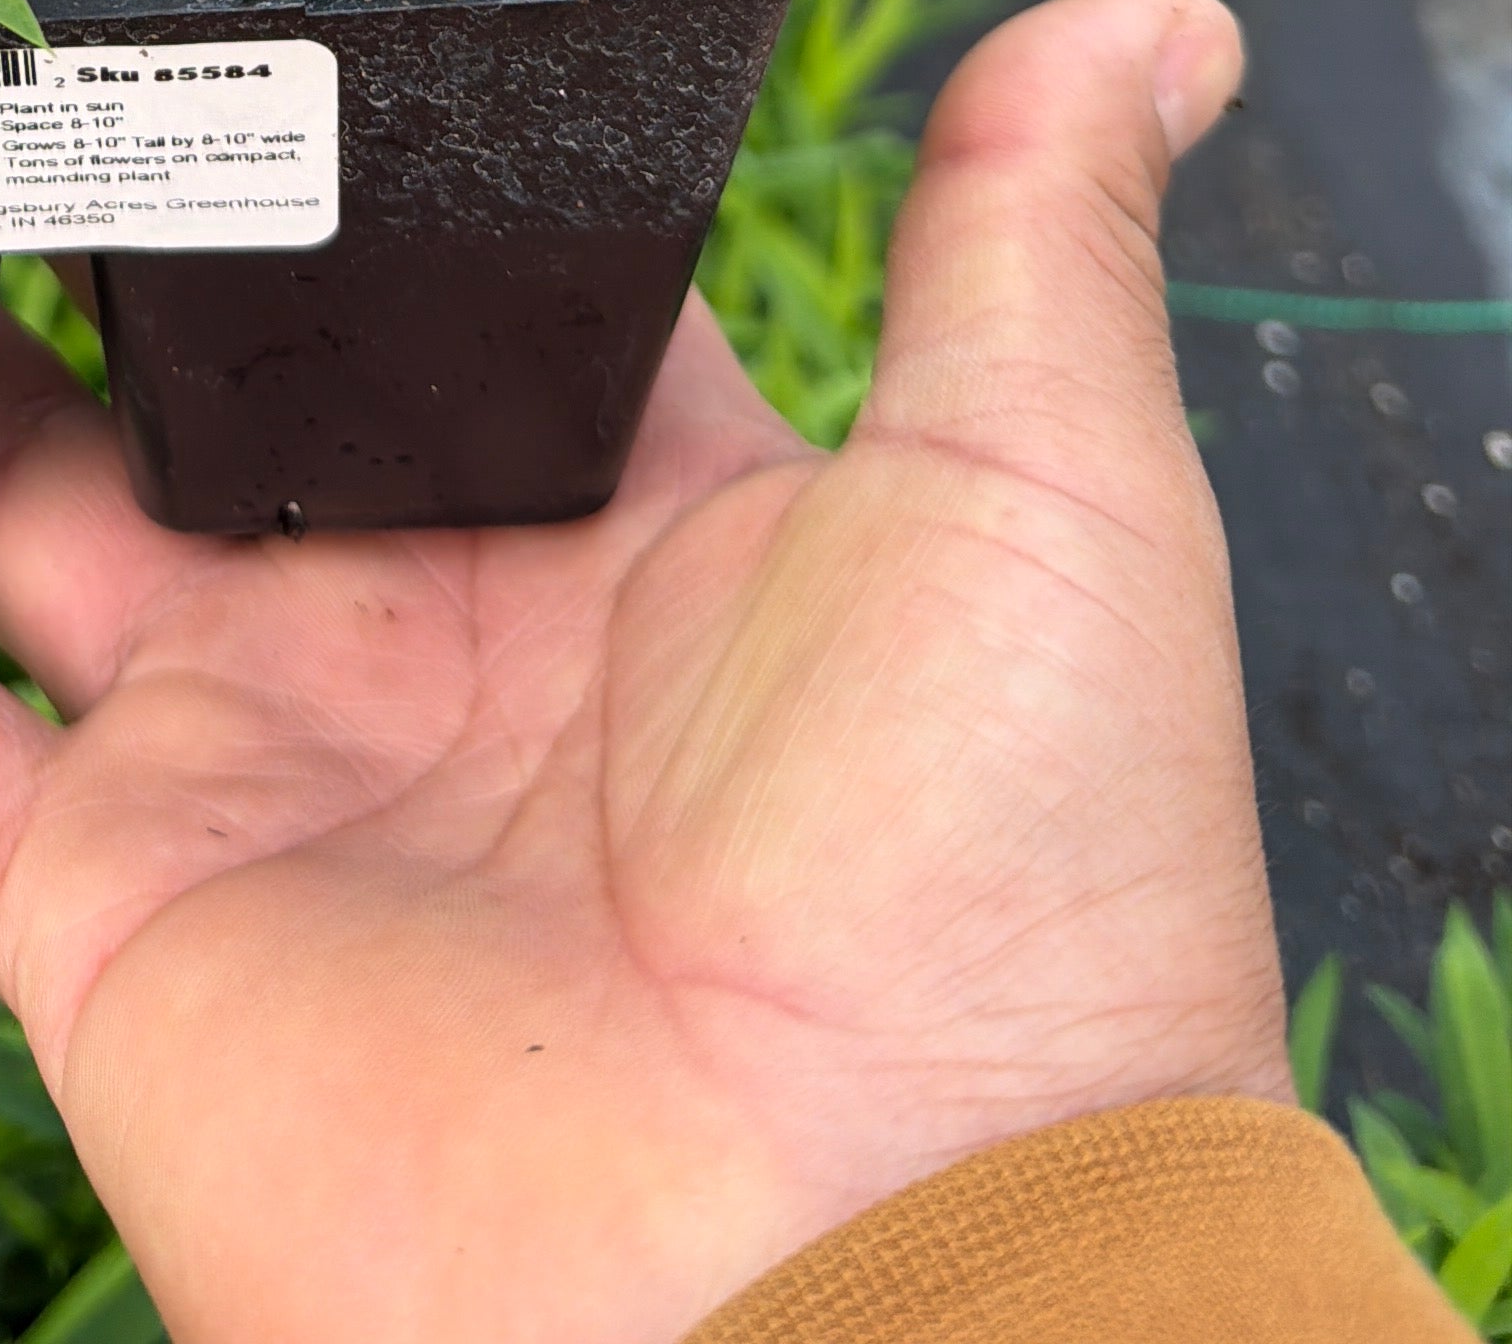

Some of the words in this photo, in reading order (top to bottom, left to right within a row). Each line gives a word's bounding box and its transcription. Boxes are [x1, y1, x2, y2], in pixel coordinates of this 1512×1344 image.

[76, 66, 139, 83] Sku
[153, 64, 272, 82] 85584
[54, 77, 65, 88] 2
[0, 102, 54, 114] Plant
[60, 101, 78, 113] in
[86, 101, 124, 112] sun
[0, 118, 63, 134] Space
[71, 116, 124, 129] 8-10"
[2, 138, 66, 151] Grows
[73, 136, 126, 149] 8-10"
[132, 136, 165, 148] Tall
[172, 135, 194, 150] by
[201, 132, 255, 145] 8-10"
[261, 131, 306, 144] wide
[6, 156, 58, 168] Tons
[64, 154, 84, 167] of
[90, 152, 166, 166] flowers
[172, 152, 198, 163] on
[5, 170, 111, 185] mounding
[118, 169, 171, 183] plant
[85, 198, 158, 211] Acres
[166, 195, 321, 209] Greenhouse
[11, 215, 36, 229] IN
[44, 212, 116, 226] 46350
